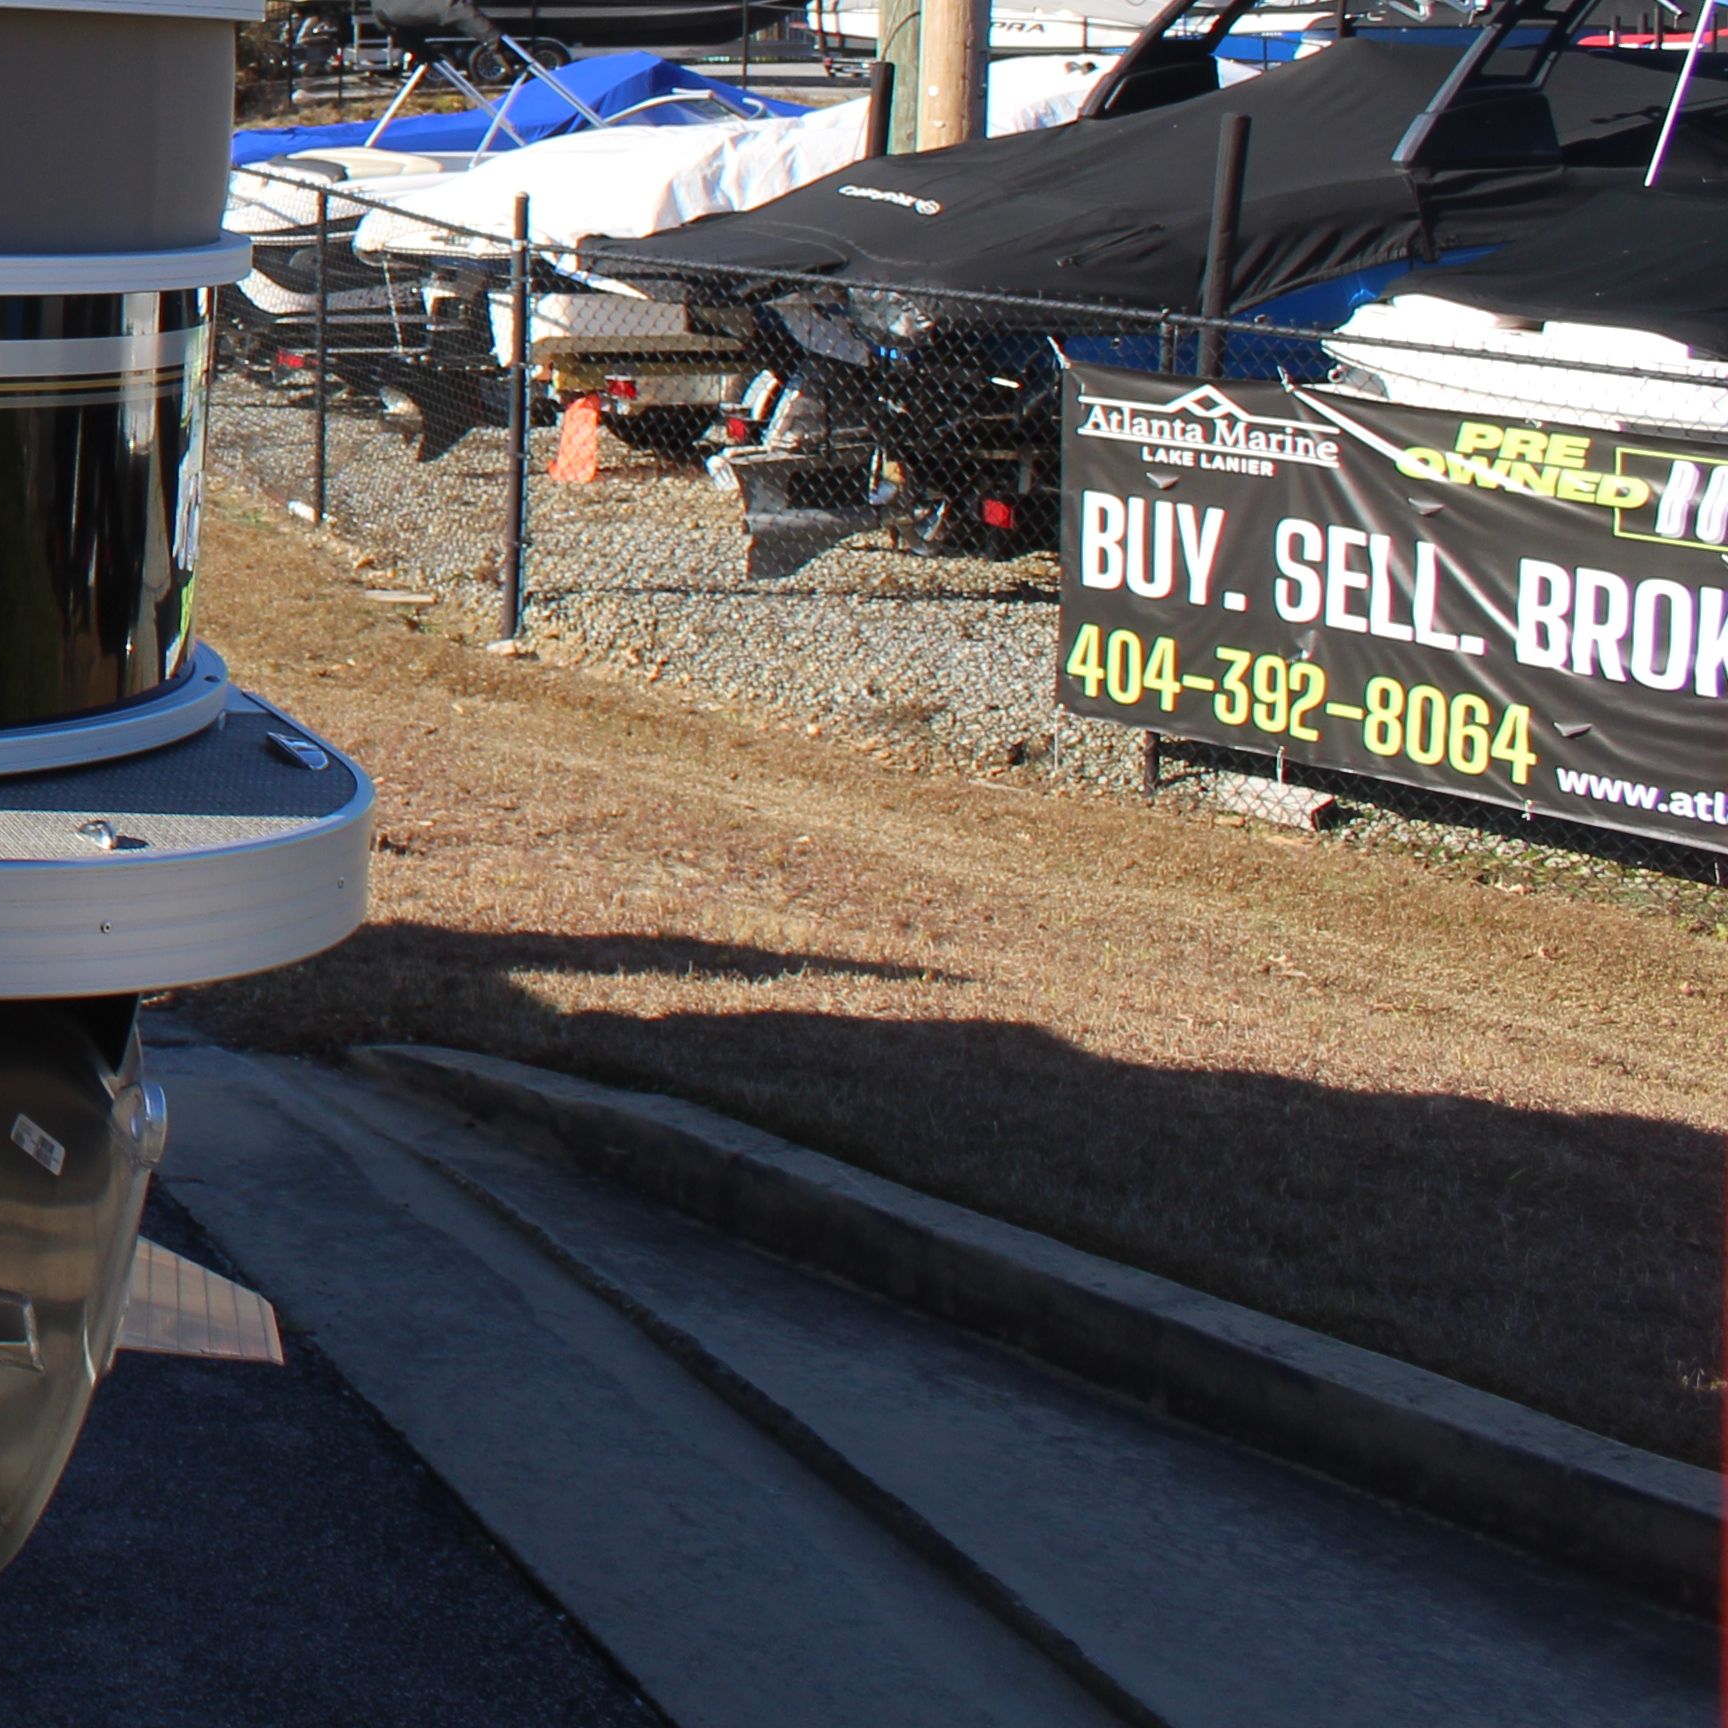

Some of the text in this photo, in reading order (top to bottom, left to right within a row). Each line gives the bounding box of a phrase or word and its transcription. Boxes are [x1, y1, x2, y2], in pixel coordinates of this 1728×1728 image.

[989, 21, 1045, 33] PRA
[1085, 404, 1339, 462] Atlanta Marine
[1142, 446, 1275, 478] LAKE LANIER
[1454, 421, 1591, 469] PRE
[1395, 446, 1652, 510] OWNED
[1081, 490, 1247, 612] BUY.
[1274, 517, 1487, 656] SELL.
[1067, 624, 1537, 785] 404-392-8064
[1556, 767, 1728, 826] www.atl
